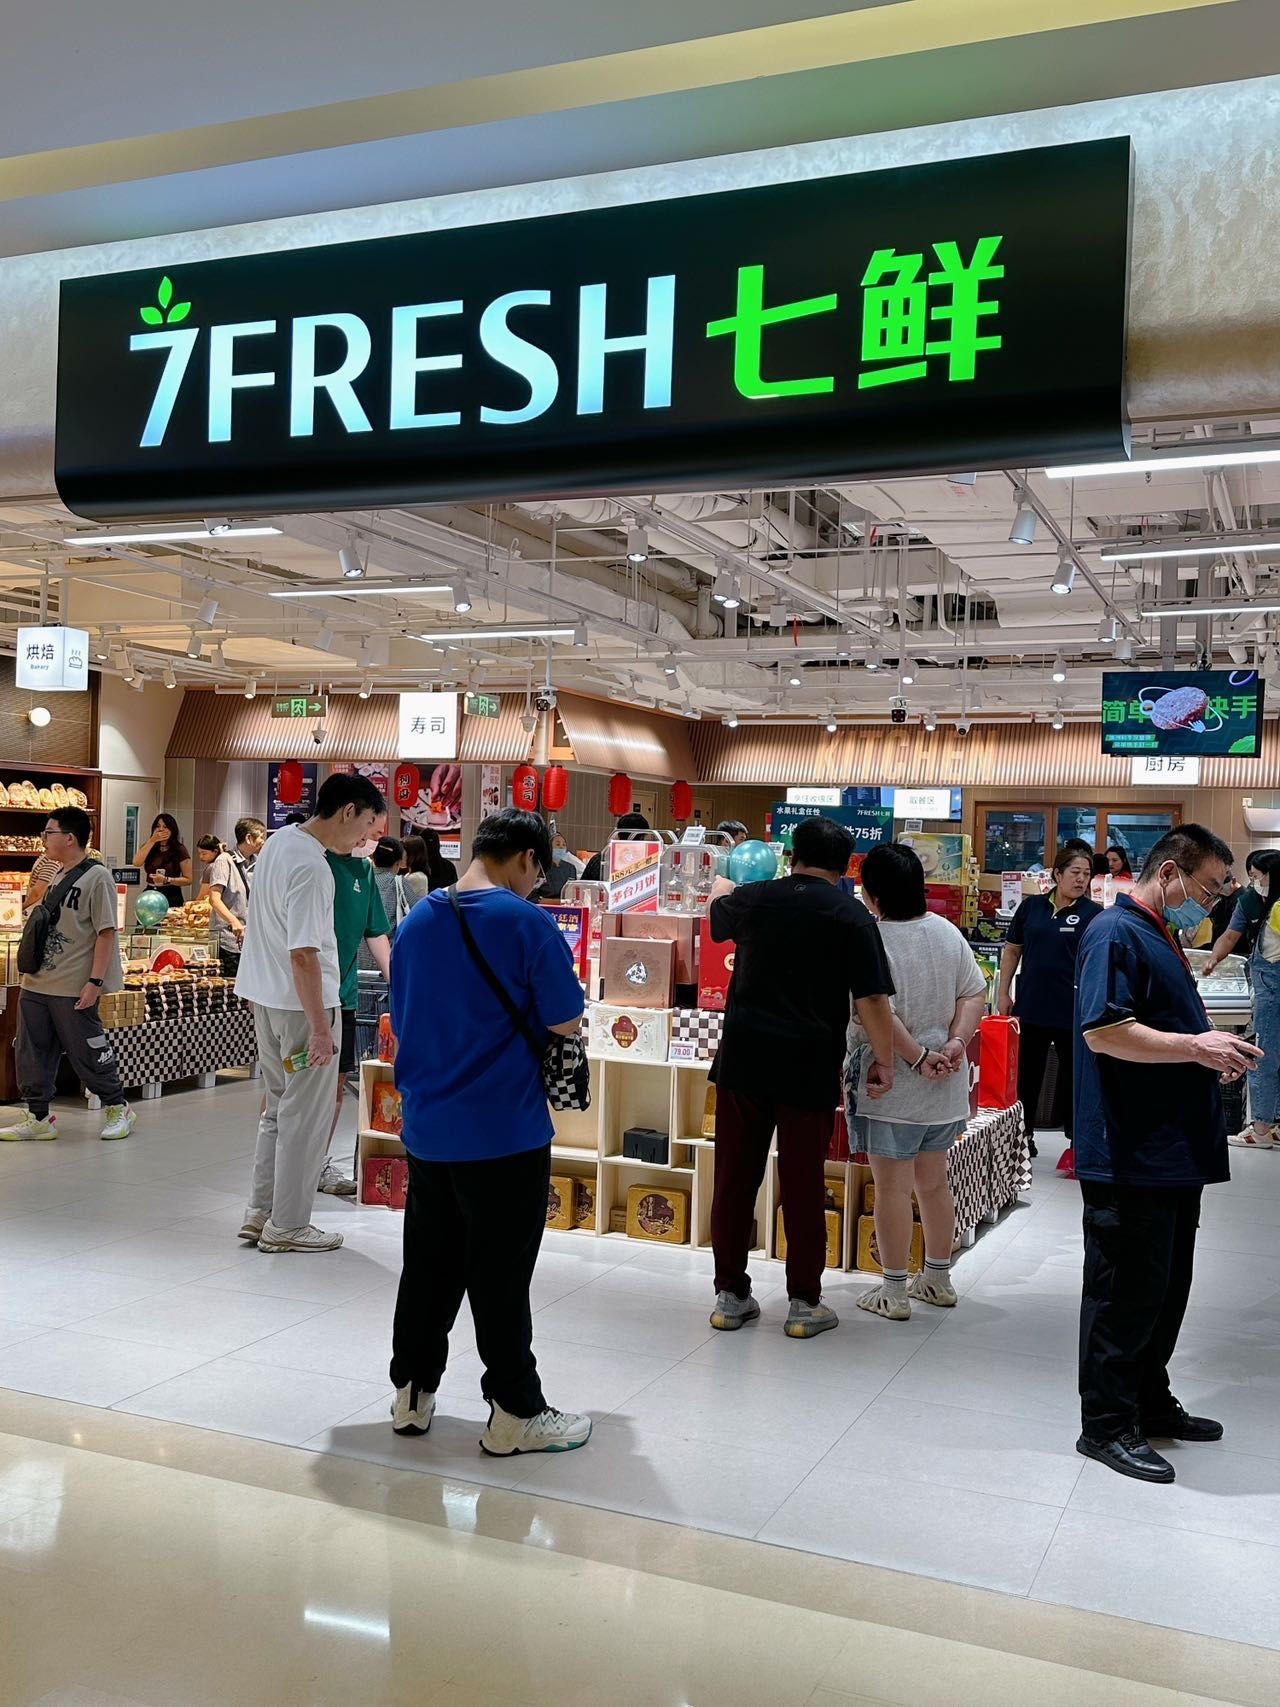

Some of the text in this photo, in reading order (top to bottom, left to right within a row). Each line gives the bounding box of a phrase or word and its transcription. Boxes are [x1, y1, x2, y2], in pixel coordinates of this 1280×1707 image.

[130, 235, 1005, 448] 7FRESH 七鲜
[26, 643, 55, 660] 烘焙
[410, 715, 446, 735] 寿司
[1145, 757, 1186, 772] 厨房
